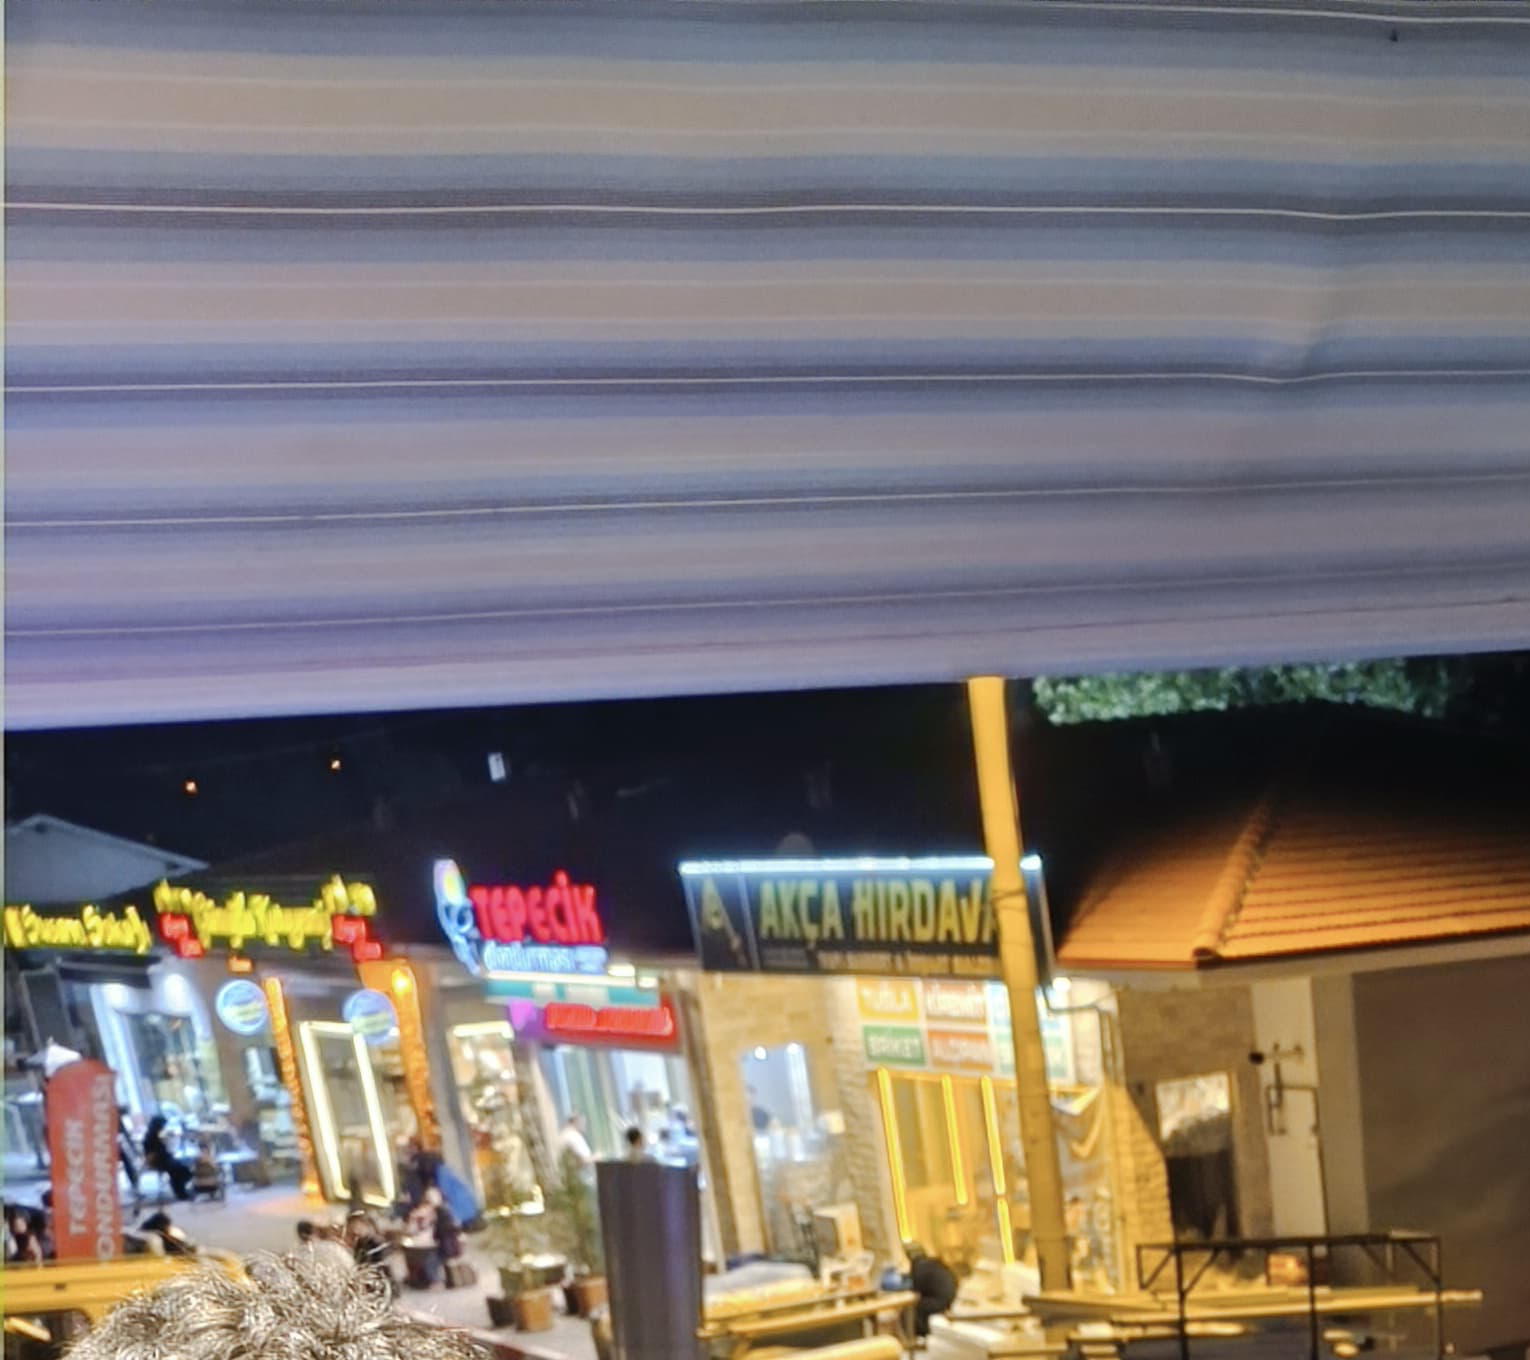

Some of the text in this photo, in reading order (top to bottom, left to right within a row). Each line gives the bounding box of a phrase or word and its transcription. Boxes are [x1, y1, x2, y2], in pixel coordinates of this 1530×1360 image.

[758, 879, 1000, 948] AKÇA HIRDAVA
[93, 1073, 115, 1262] ONDURMASI
